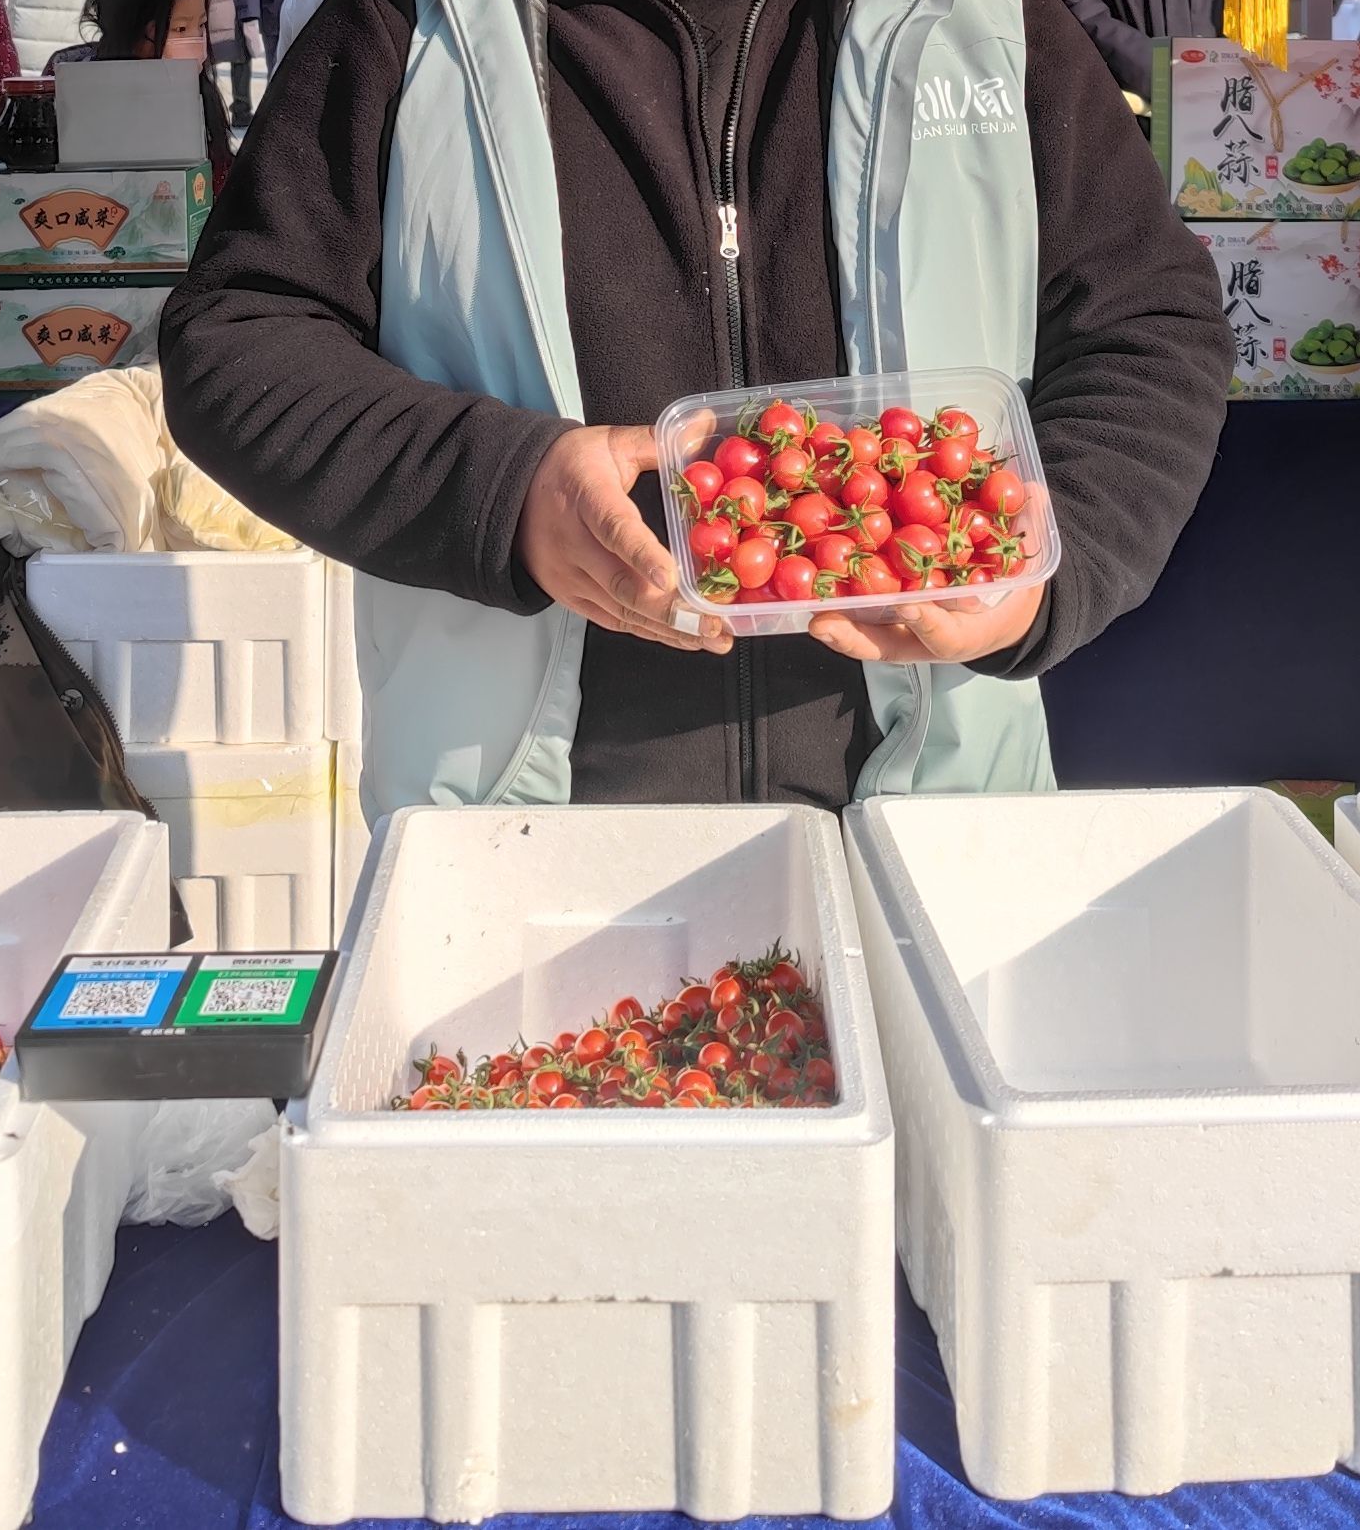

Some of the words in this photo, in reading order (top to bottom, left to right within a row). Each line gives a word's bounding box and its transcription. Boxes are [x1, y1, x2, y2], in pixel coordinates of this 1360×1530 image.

[945, 124, 967, 136] SHUI
[971, 122, 999, 134] REN
[1002, 122, 1018, 133] JIA
[1212, 74, 1264, 185] 腊八蒜
[33, 207, 115, 230] 爽口咸菜
[1224, 259, 1272, 368] 腊八蒜
[37, 324, 117, 347] 爽口咸菜
